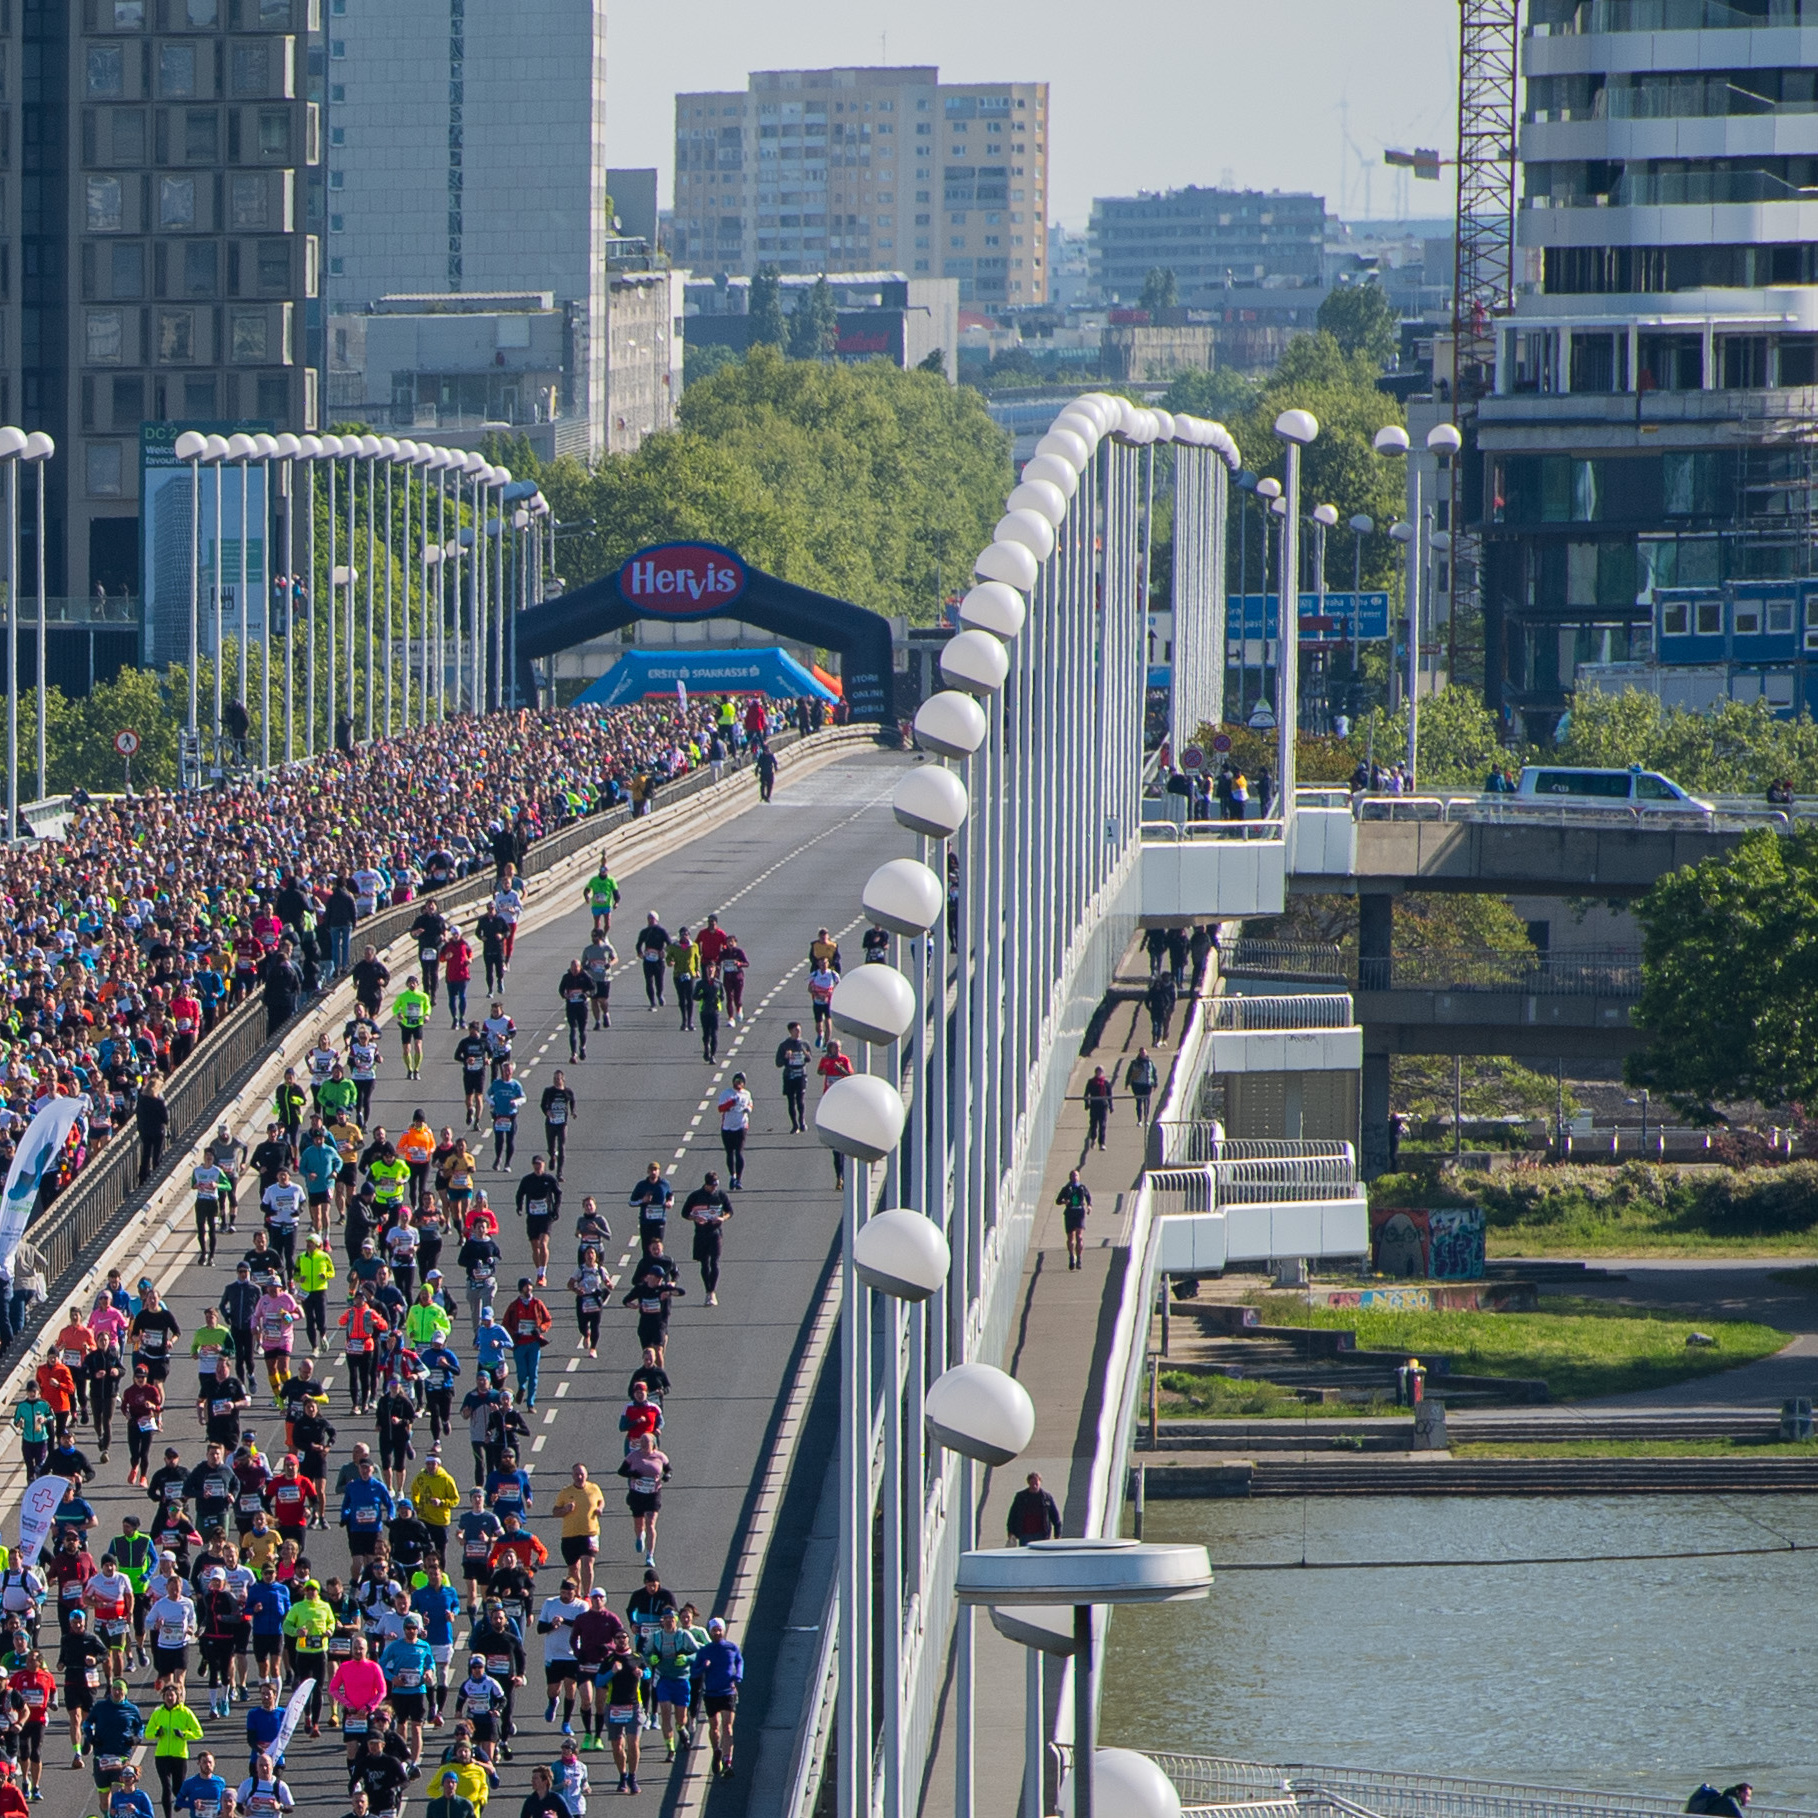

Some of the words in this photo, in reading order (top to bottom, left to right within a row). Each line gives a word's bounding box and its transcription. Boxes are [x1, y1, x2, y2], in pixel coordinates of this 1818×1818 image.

[145, 428, 166, 439] DC
[145, 445, 176, 455] Welco
[632, 561, 736, 600] Hervis
[693, 667, 748, 678] SPARKASSE
